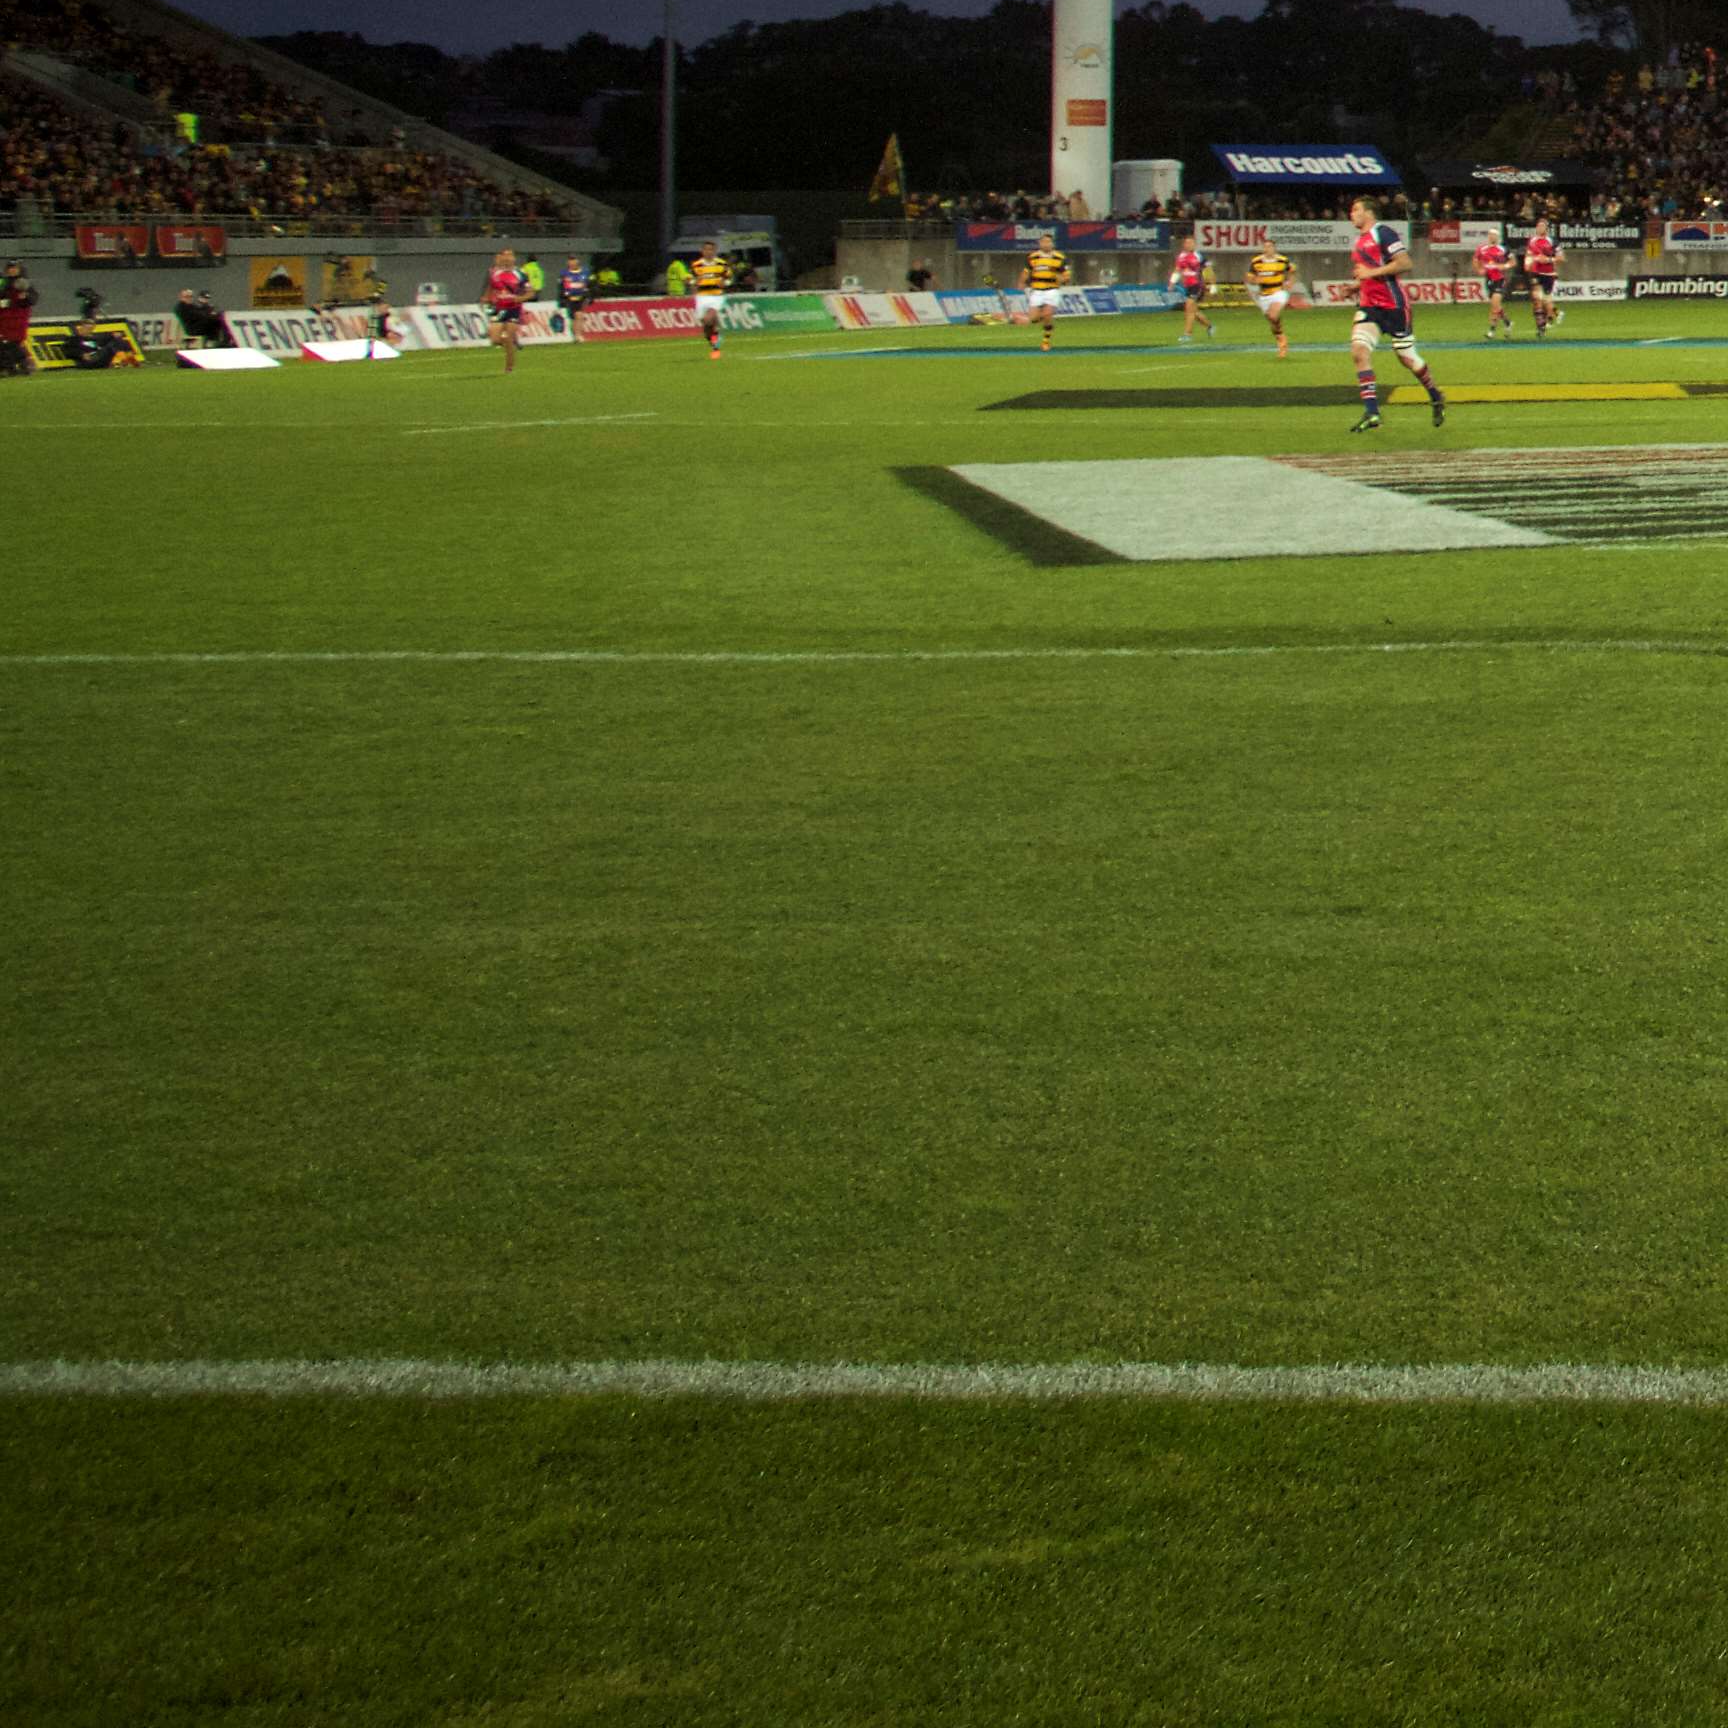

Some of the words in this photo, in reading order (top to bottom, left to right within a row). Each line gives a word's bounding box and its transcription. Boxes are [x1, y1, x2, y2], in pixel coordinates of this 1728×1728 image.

[1059, 137, 1069, 152] 3
[1226, 152, 1385, 175] Harcourts
[1116, 224, 1159, 243] Budget
[1201, 224, 1268, 248] SHUK
[1559, 223, 1639, 241] Refrigeration
[1404, 280, 1487, 305] ORNER
[1555, 284, 1584, 297] HUK
[582, 310, 644, 334] RICOH
